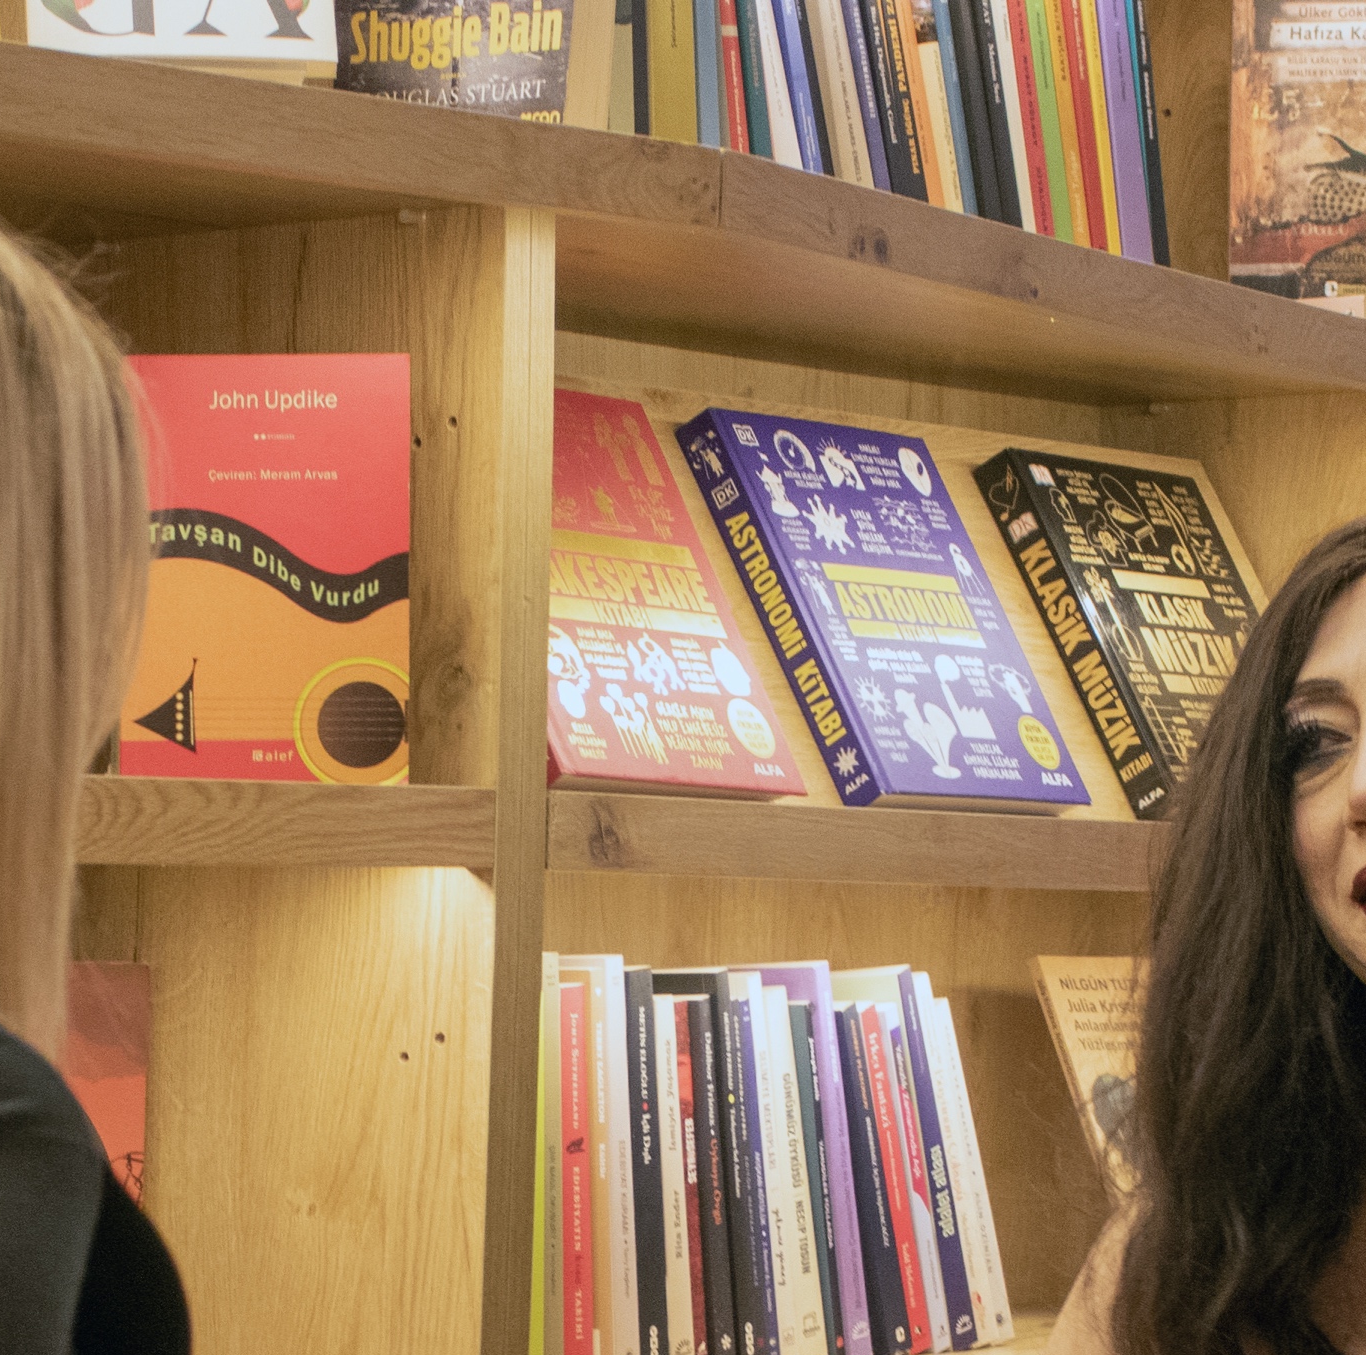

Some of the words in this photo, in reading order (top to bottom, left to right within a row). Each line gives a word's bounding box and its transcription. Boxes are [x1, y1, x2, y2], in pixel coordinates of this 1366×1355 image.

[349, 9, 481, 69] Shuggie
[489, 6, 562, 55] Bain
[1289, 26, 1343, 41] Hafıza
[888, 18, 909, 93] PANDEMİ
[465, 78, 545, 104] STUART
[209, 389, 259, 411] John
[264, 388, 338, 413] Updike
[737, 427, 756, 443] DK
[208, 469, 258, 483] Çeviren:
[260, 469, 301, 481] Meram
[304, 469, 338, 481] Arvas
[716, 483, 737, 505] DK
[149, 521, 243, 552] Tavşan
[252, 545, 302, 592] Dibe
[310, 579, 380, 608] Vurdu
[549, 553, 716, 613] AKESPEARE
[596, 601, 651, 629] KİTABI
[834, 581, 979, 631] ASTRONOMİ
[1134, 591, 1215, 632] KLASİK
[725, 511, 807, 660] ASTRONOMİ
[793, 657, 848, 748] KİTABI
[1018, 537, 1093, 658] KLASİK
[1072, 649, 1142, 761] MÜZİK
[1119, 751, 1154, 784] KİTABI
[753, 762, 784, 778] ALFA
[845, 773, 871, 795] ALFA
[1041, 771, 1073, 788] ALFA
[1137, 786, 1166, 811] ALFA
[1059, 974, 1108, 991] NİLGÜN
[1067, 999, 1097, 1014] Julia
[782, 1073, 796, 1137] GÜNÜMÜZ
[788, 1138, 803, 1190] ÖYKÜSÜ
[930, 1143, 948, 1189] atlası
[794, 1200, 808, 1237] NECİP
[938, 1188, 956, 1239] adalet
[798, 1237, 812, 1275] TOSUN
